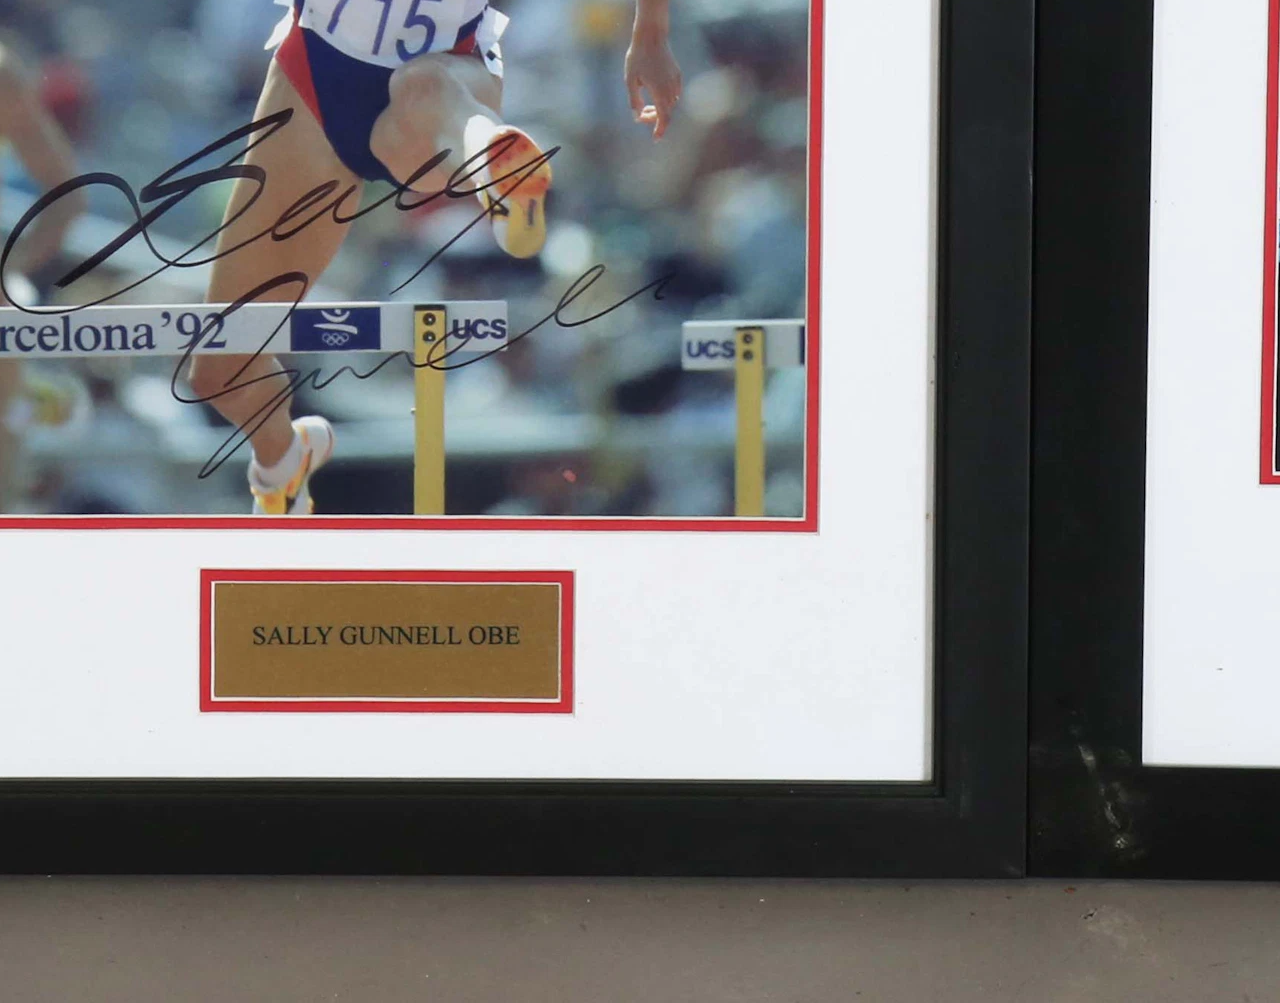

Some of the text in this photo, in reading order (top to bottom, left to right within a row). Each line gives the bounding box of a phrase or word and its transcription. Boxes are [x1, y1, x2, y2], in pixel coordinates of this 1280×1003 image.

[452, 318, 507, 340] UCS
[686, 339, 736, 359] UCS
[252, 626, 521, 646] SALLY GUNNELL OBE
